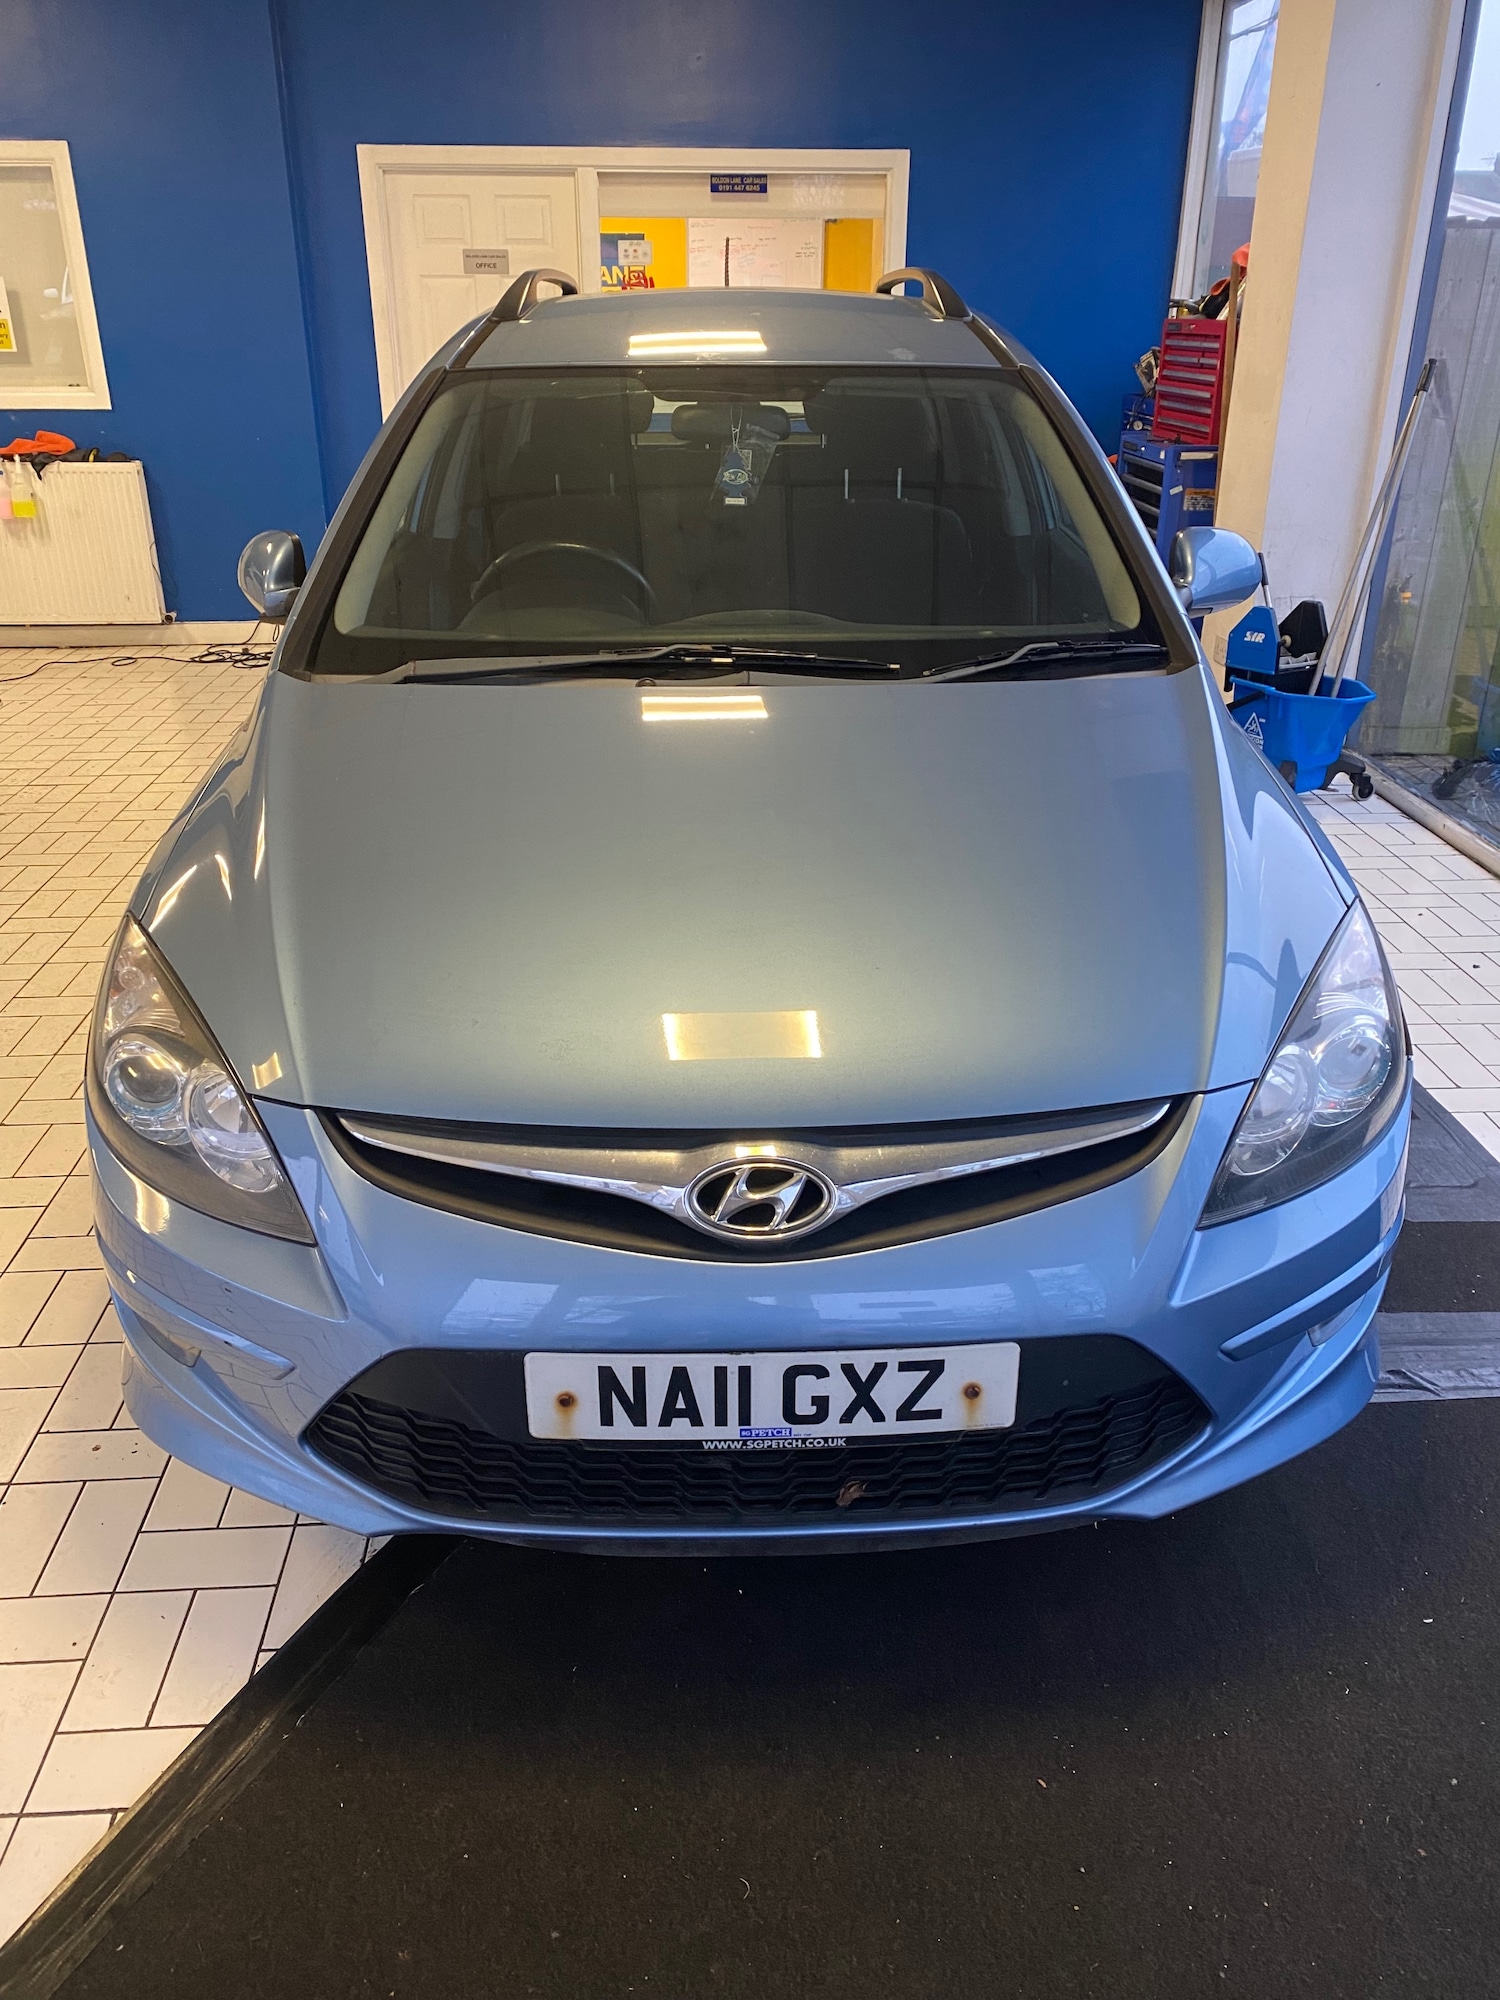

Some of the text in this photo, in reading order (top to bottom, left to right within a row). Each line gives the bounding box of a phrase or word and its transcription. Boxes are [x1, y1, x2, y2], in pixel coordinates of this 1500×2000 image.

[1243, 630, 1266, 644] SIR
[781, 1358, 946, 1426] GXZ
[751, 1428, 791, 1437] PETCH
[702, 1437, 847, 1450] WWW.SGPETCH.CO.UK
